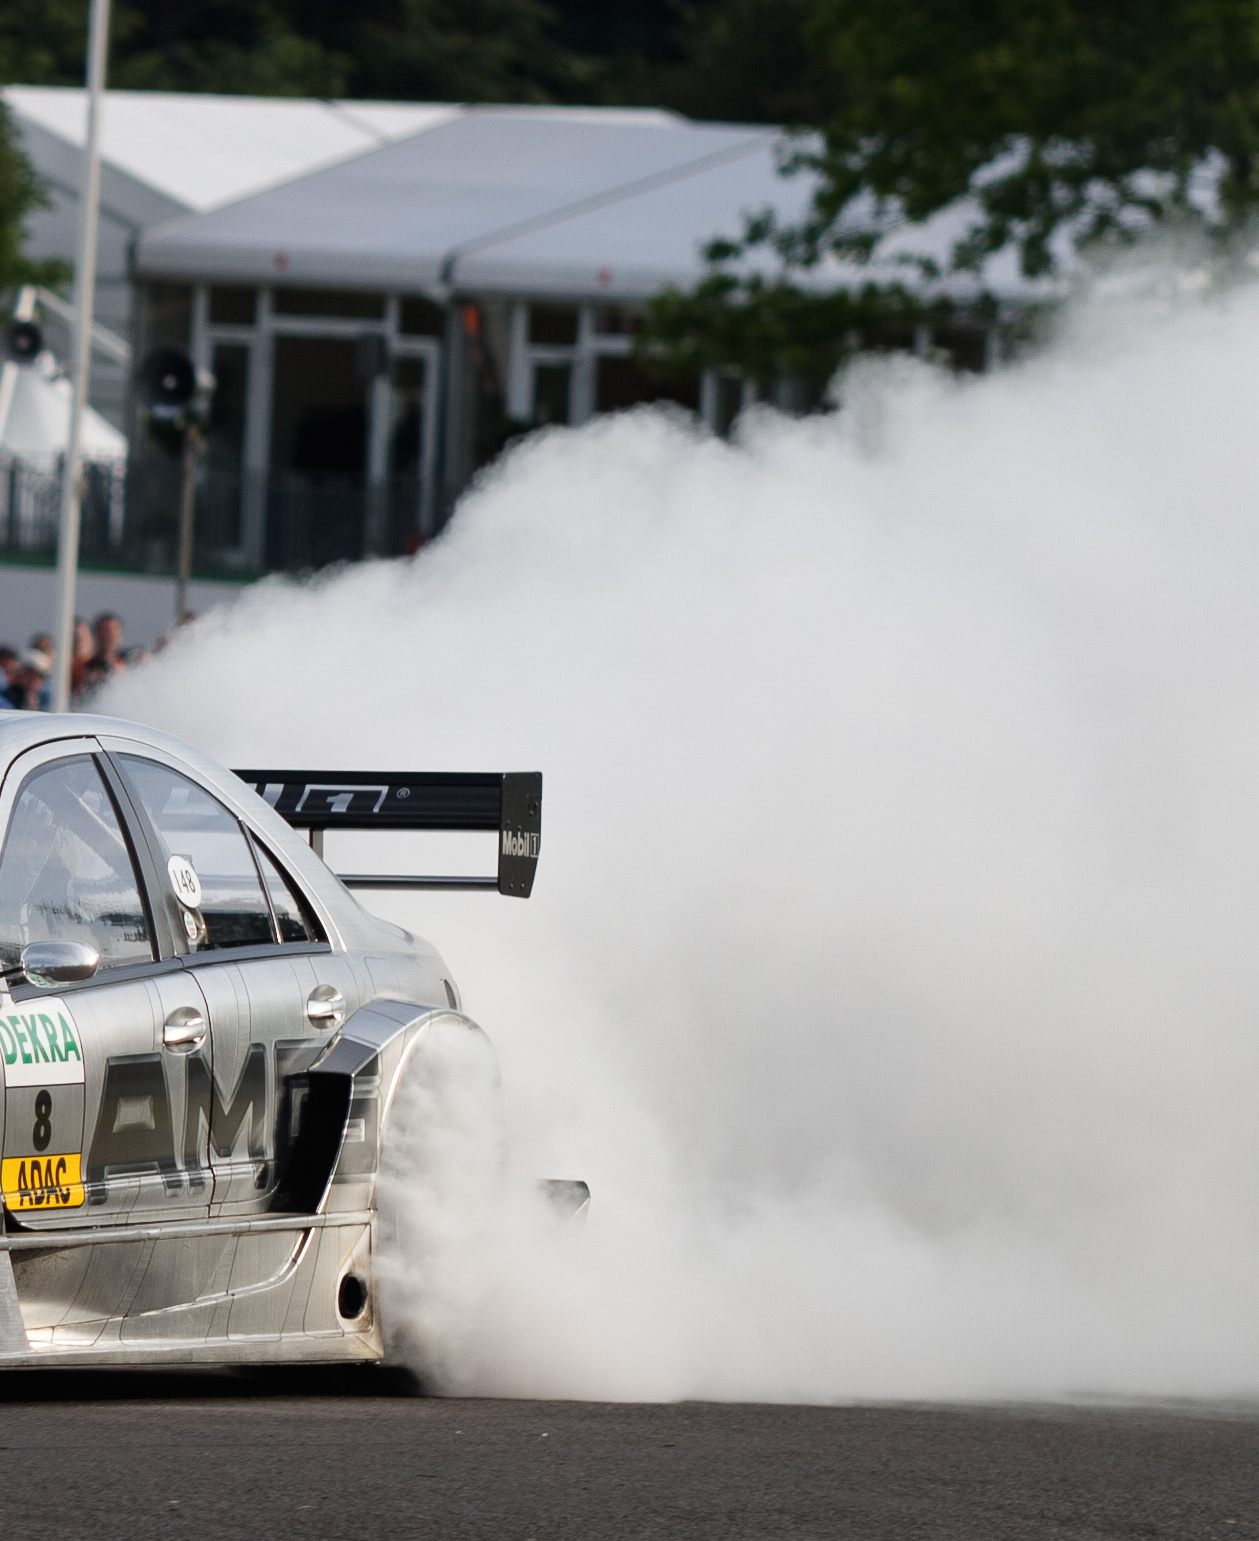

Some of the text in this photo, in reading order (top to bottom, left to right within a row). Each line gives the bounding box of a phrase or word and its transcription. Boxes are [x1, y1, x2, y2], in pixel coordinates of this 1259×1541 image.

[502, 830, 530, 857] Mobil
[172, 869, 196, 893] 148
[32, 1089, 53, 1152] 8
[17, 1157, 71, 1207] ADAC
